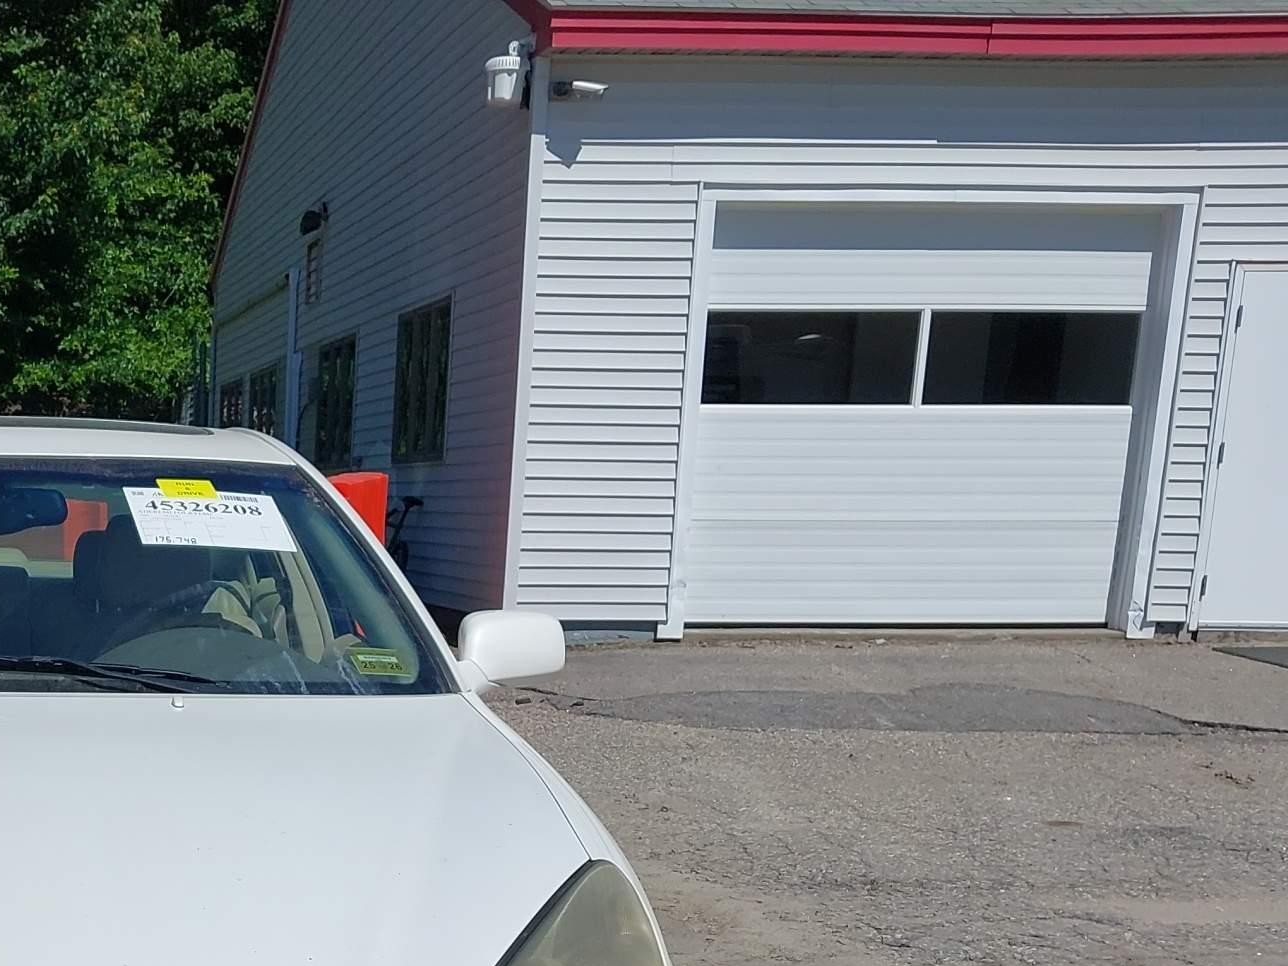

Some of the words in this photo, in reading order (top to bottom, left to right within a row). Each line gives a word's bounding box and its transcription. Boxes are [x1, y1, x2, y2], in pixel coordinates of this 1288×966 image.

[145, 500, 262, 517] 45326208
[361, 661, 376, 669] 25
[388, 662, 403, 670] 26
